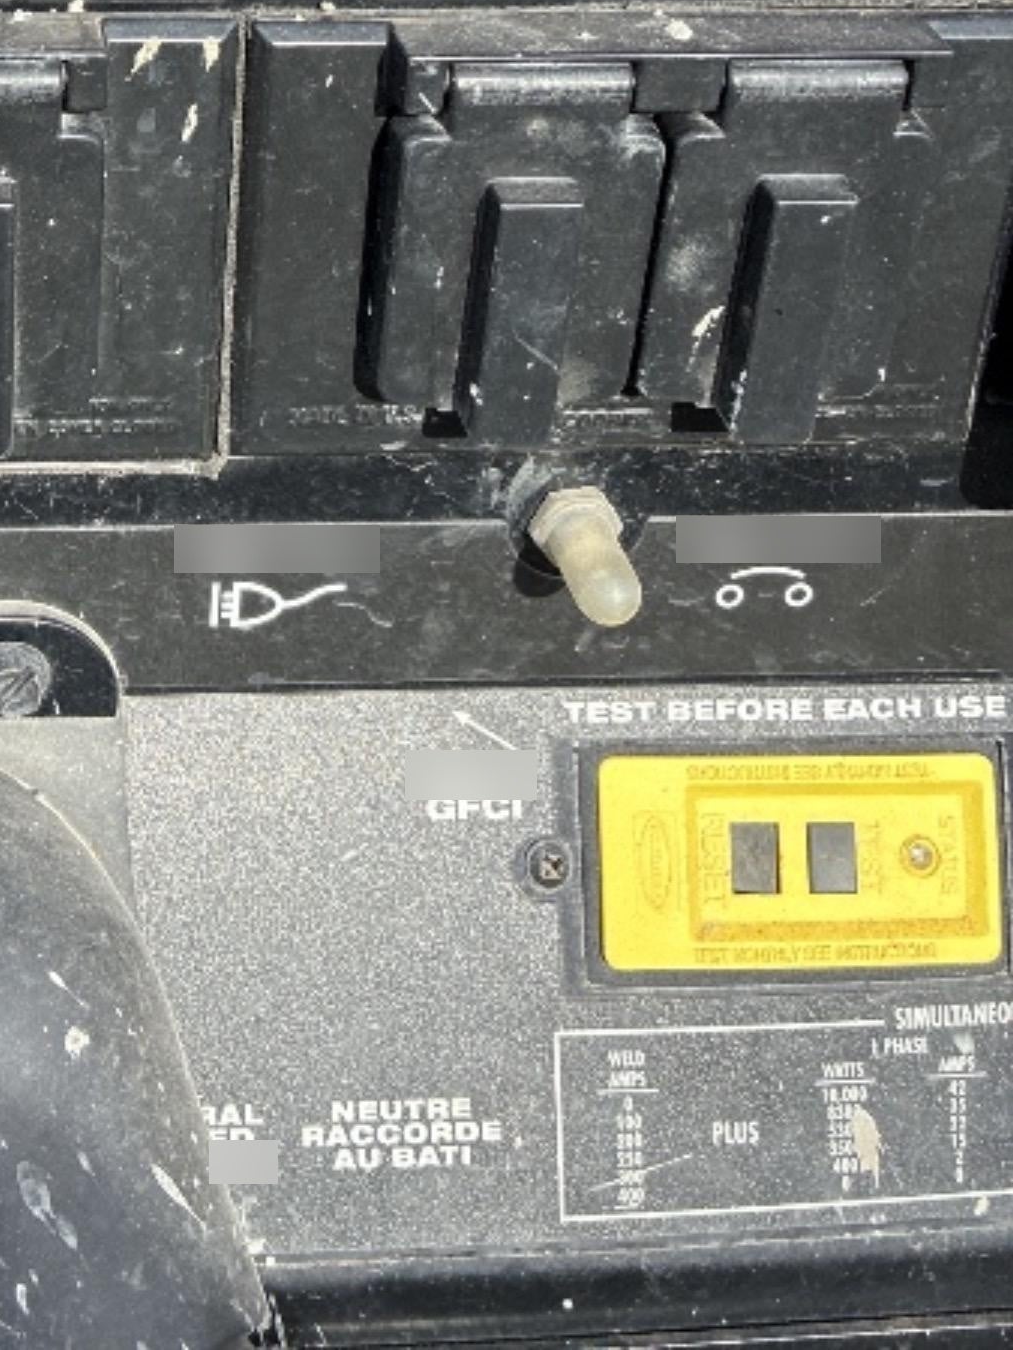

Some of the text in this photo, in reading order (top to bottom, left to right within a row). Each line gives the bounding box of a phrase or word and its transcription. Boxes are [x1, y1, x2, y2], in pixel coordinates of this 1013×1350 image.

[564, 695, 1008, 723] TEST BEFORE EACH USE
[426, 800, 522, 821] GFCI
[821, 1061, 865, 1078] WATTS
[331, 1097, 472, 1122] NEUTRE
[301, 1122, 503, 1147] RACCORDE
[712, 1120, 760, 1145] PLUS
[333, 1145, 472, 1170] AU BATI
